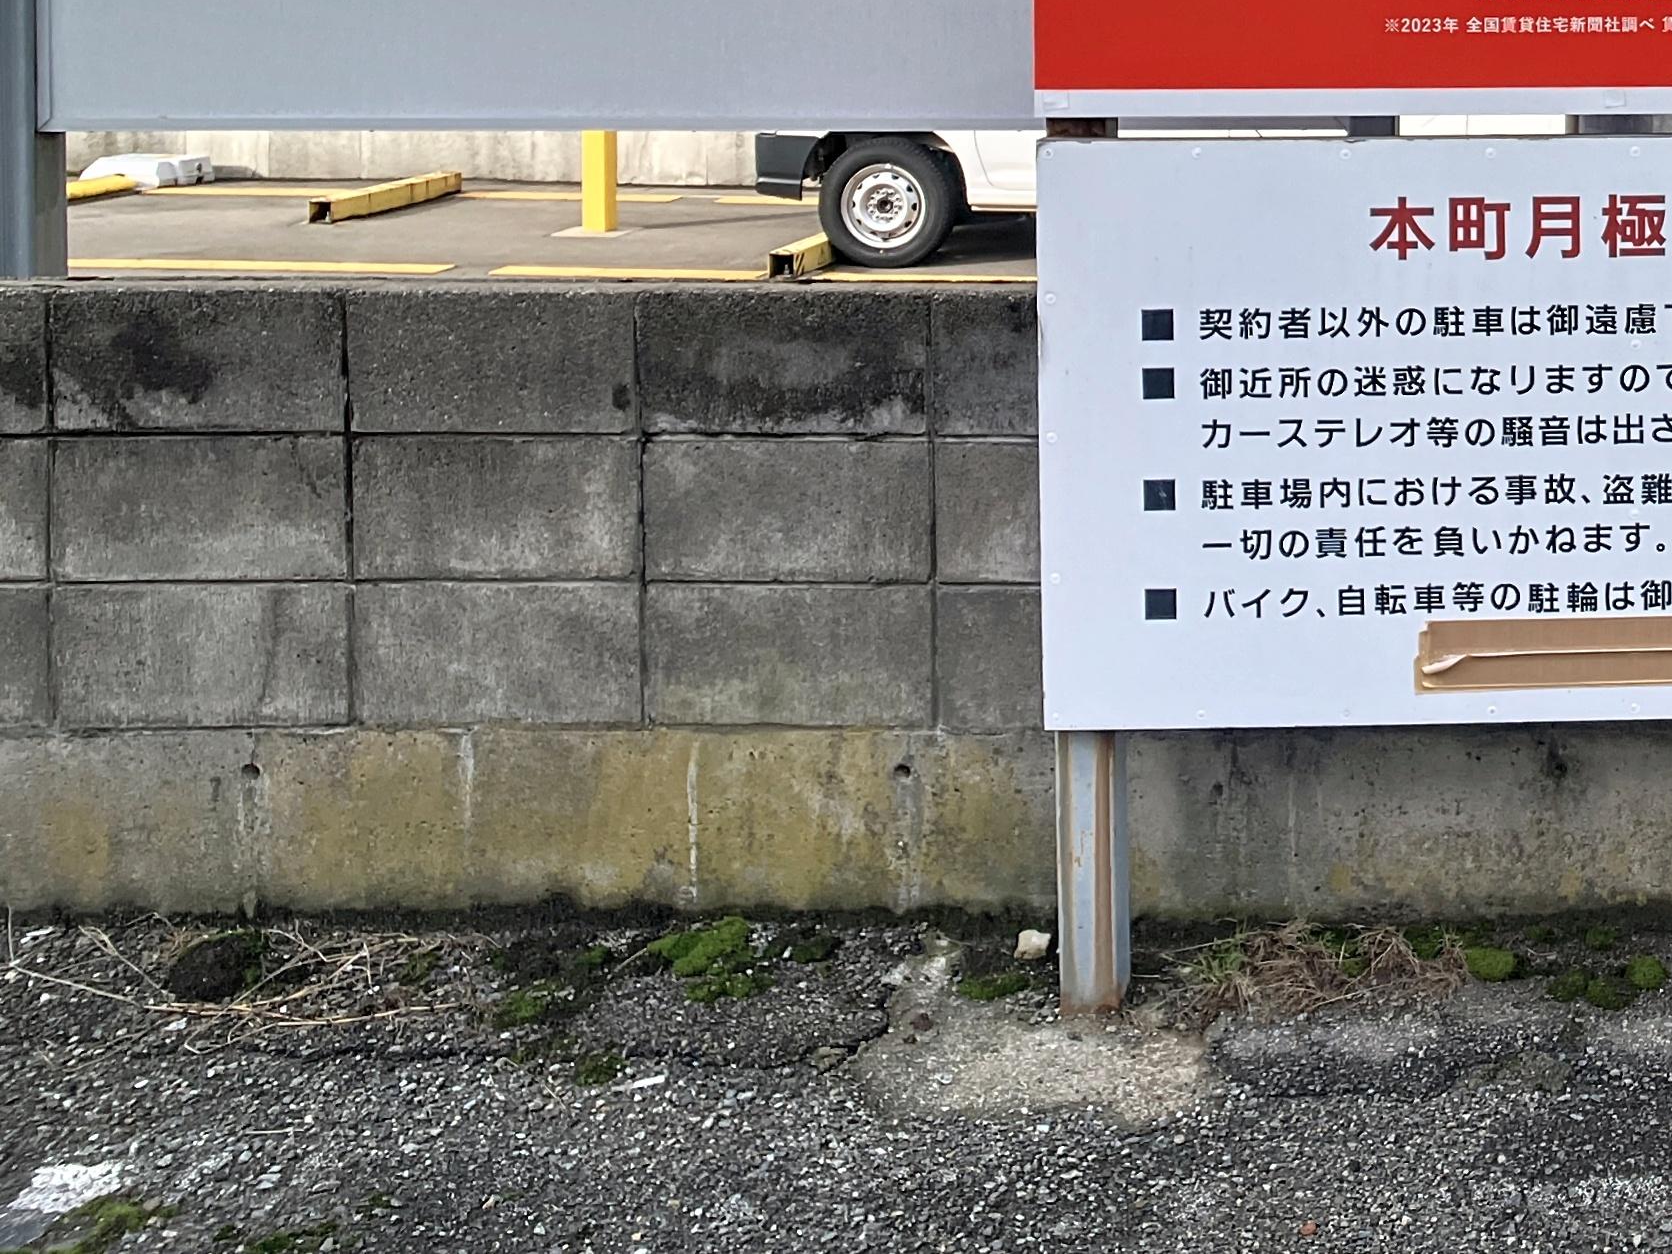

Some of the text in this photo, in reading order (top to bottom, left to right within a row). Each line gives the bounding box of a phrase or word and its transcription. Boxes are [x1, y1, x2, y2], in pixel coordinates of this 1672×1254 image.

[1202, 523, 1665, 560] 一切の責任を負いかねます。
